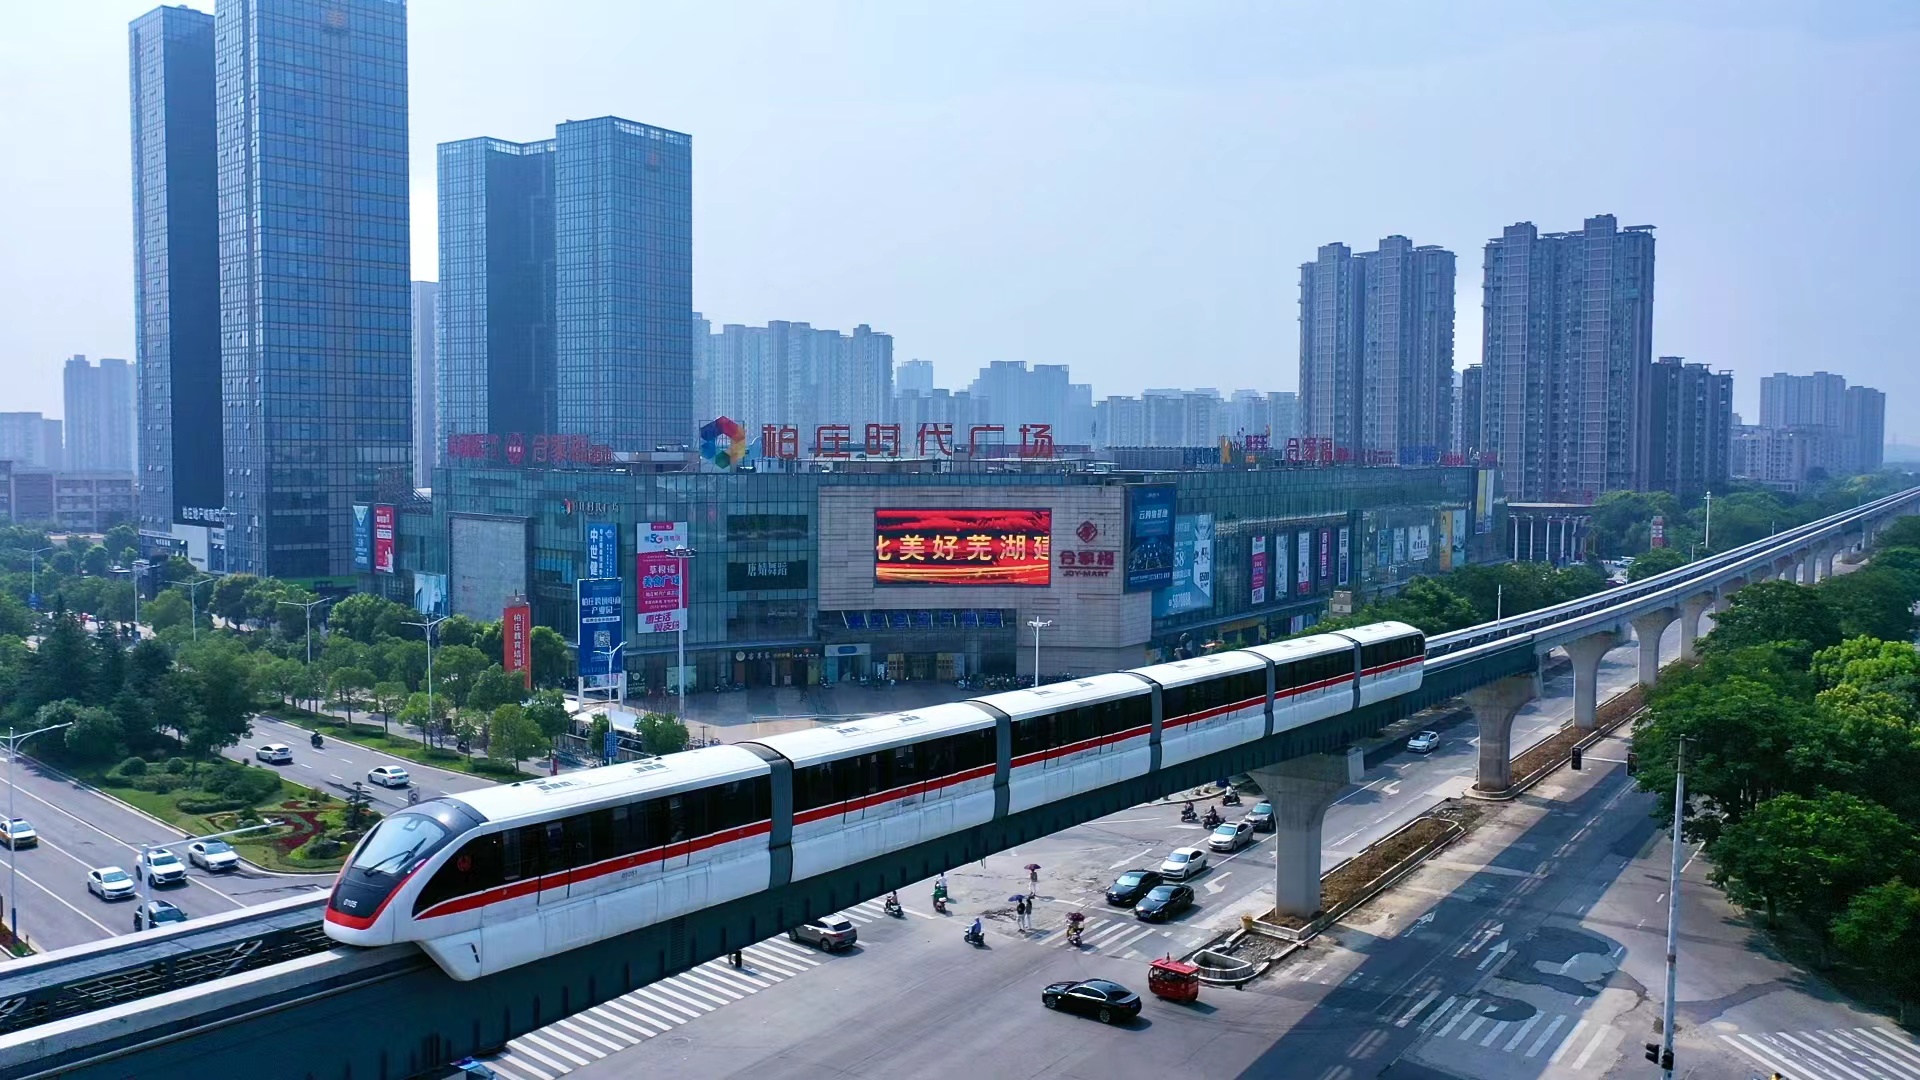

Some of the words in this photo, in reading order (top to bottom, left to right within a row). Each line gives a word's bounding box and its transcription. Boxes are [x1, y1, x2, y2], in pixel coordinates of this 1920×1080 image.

[762, 423, 1052, 459] 柏庄时代广场
[1059, 550, 1114, 566] 合家福
[343, 898, 358, 909] 0105
